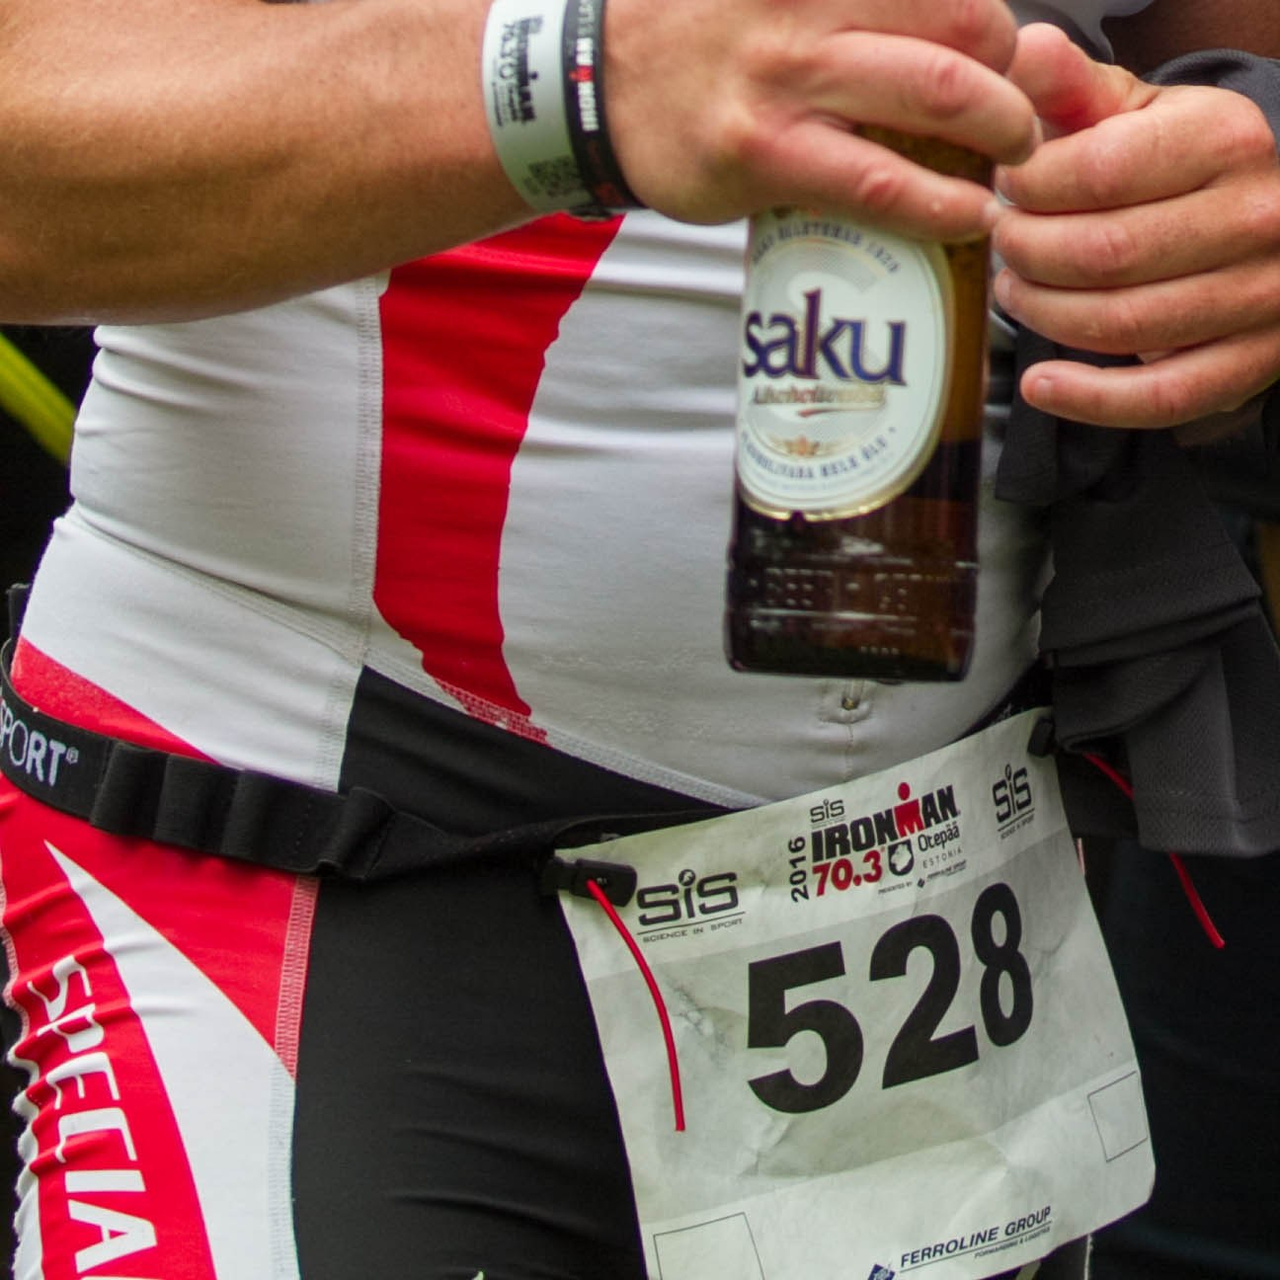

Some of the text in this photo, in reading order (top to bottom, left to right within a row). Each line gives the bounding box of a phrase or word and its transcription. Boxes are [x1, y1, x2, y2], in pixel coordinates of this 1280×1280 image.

[743, 287, 908, 386] saku
[811, 782, 959, 863] IRONMAN
[917, 821, 960, 852] Otepää
[788, 835, 810, 903] 2016
[812, 849, 884, 897] 70.3
[922, 848, 963, 869] ESTONIA
[643, 918, 743, 944] SCIENCE IN SPORT
[747, 882, 1034, 1114] 528
[27, 955, 158, 1280] SPECIA
[900, 1205, 1051, 1268] FERROLINE GROUP
